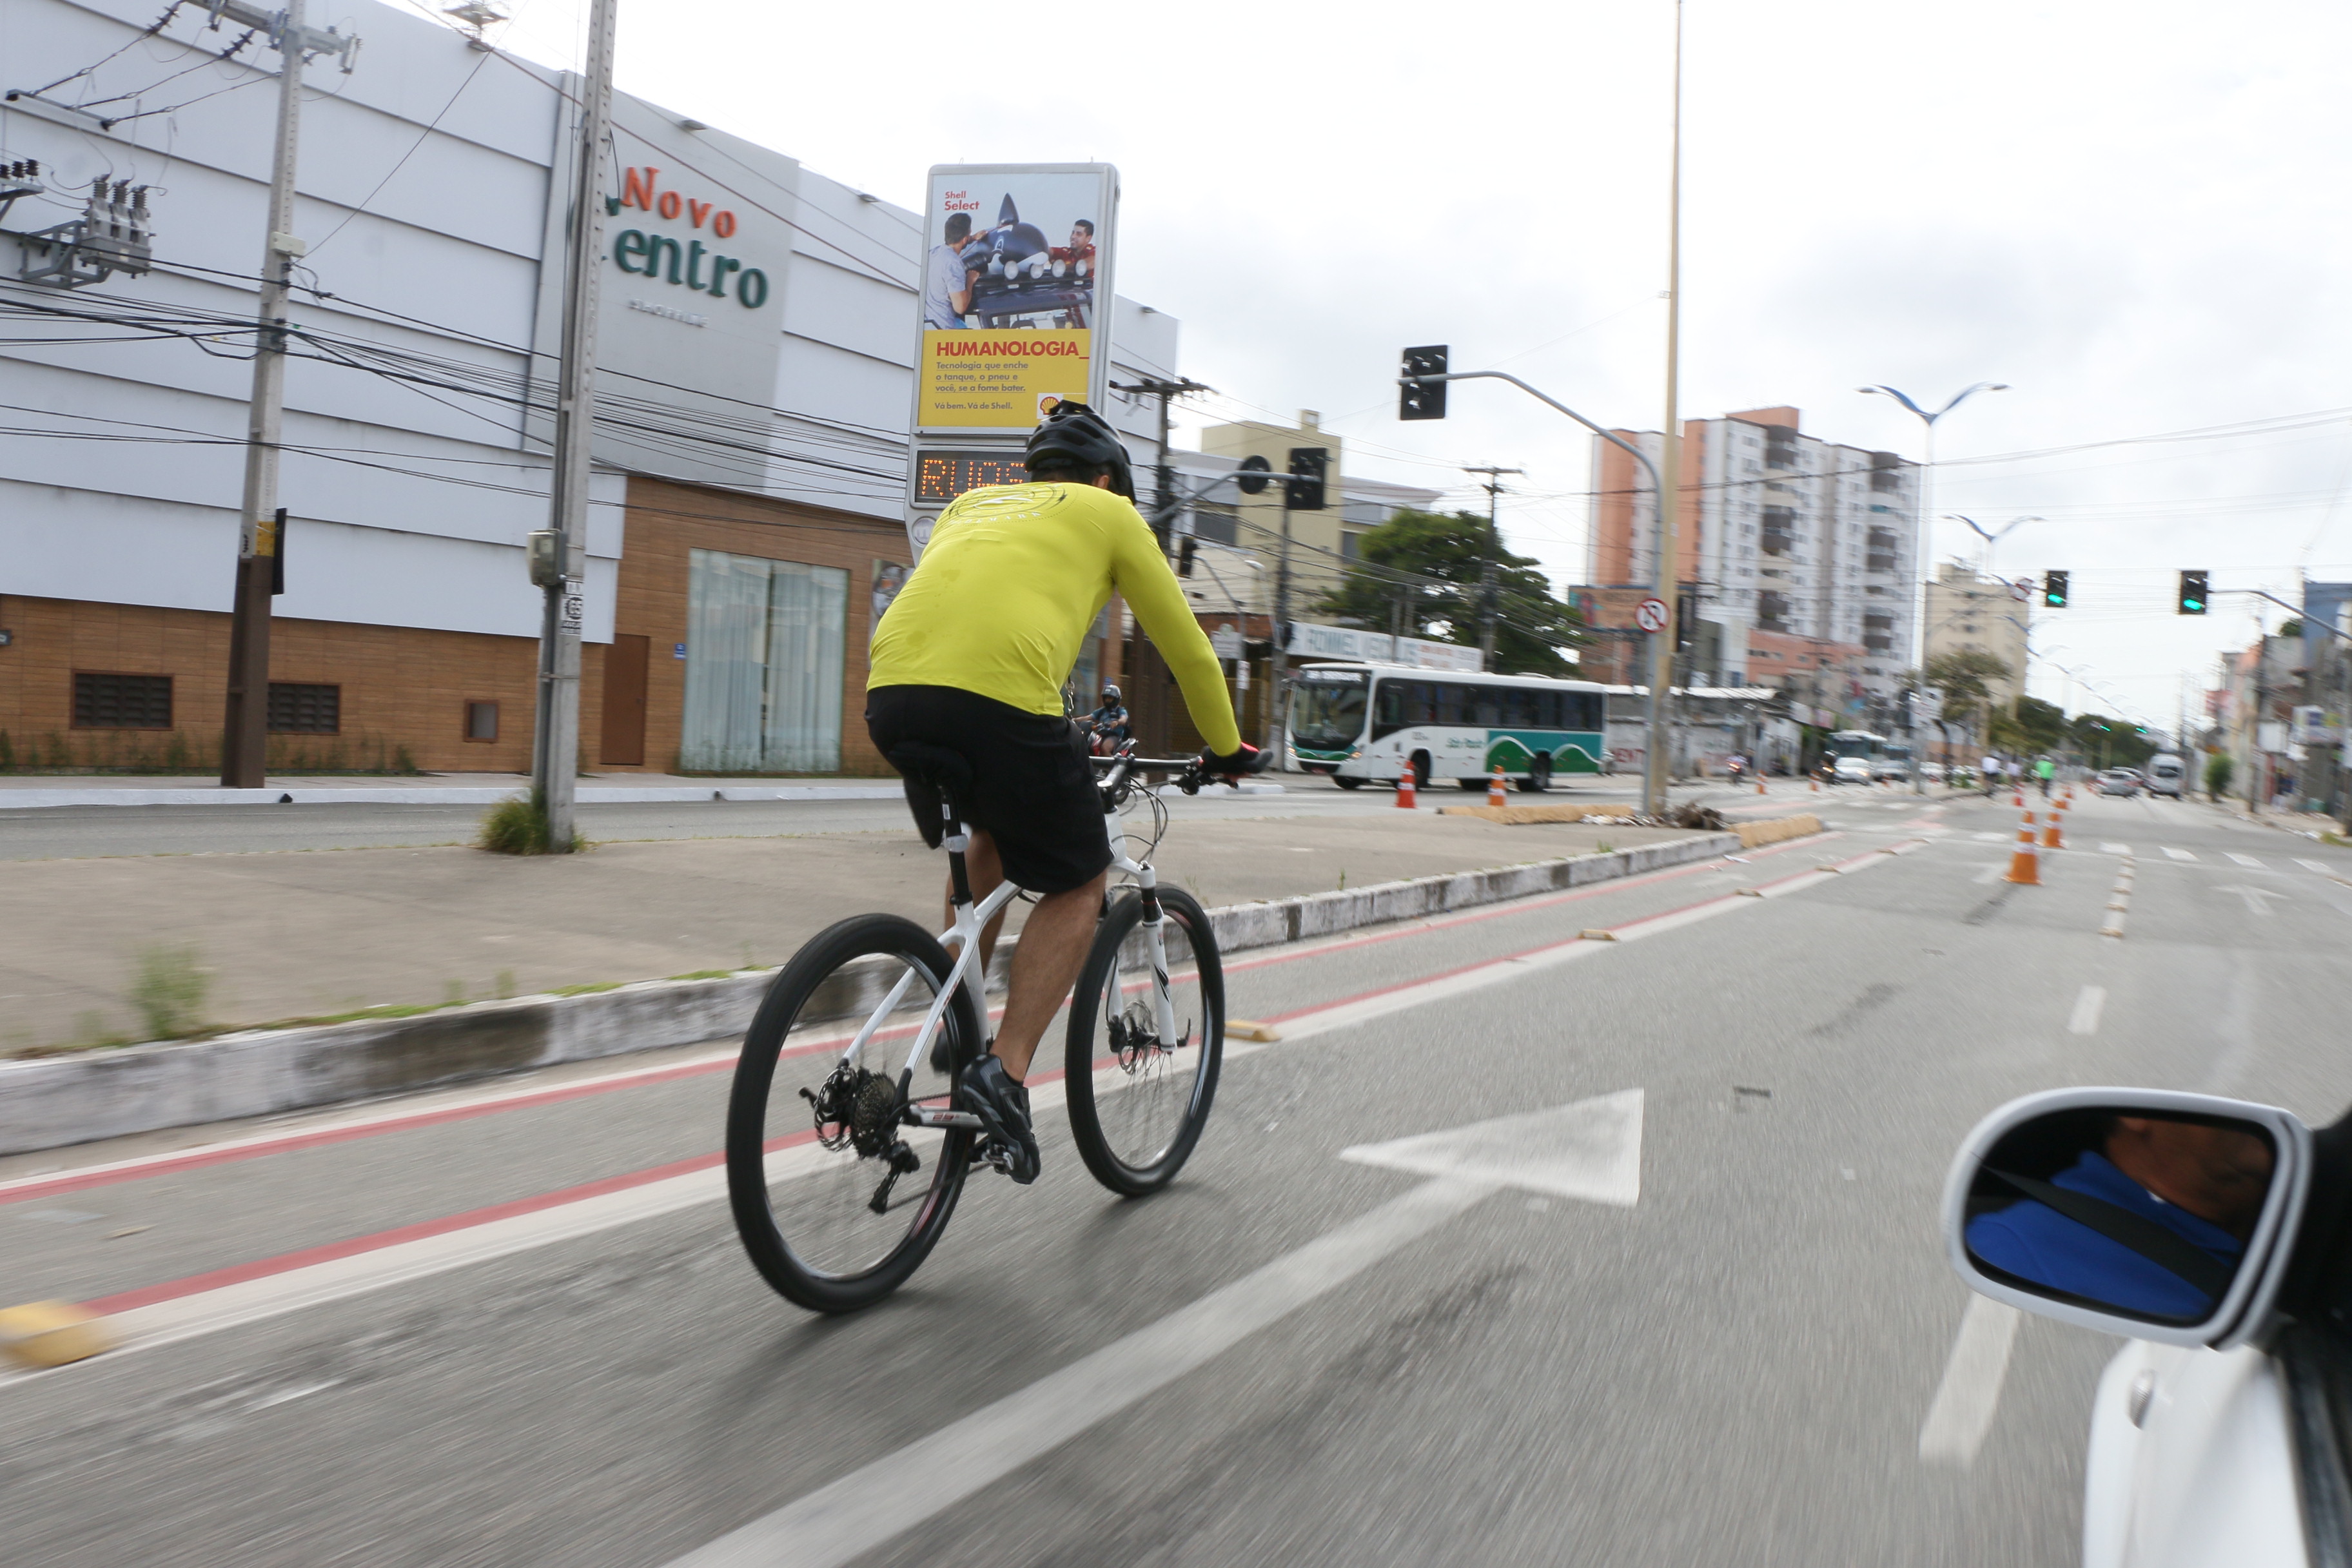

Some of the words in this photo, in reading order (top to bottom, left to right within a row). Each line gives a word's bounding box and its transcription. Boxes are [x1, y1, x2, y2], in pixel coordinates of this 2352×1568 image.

[945, 190, 966, 199] Shell
[620, 166, 737, 238] Novo
[944, 199, 980, 211] Select
[936, 361, 981, 371] Tecnologia
[936, 384, 956, 393] você,
